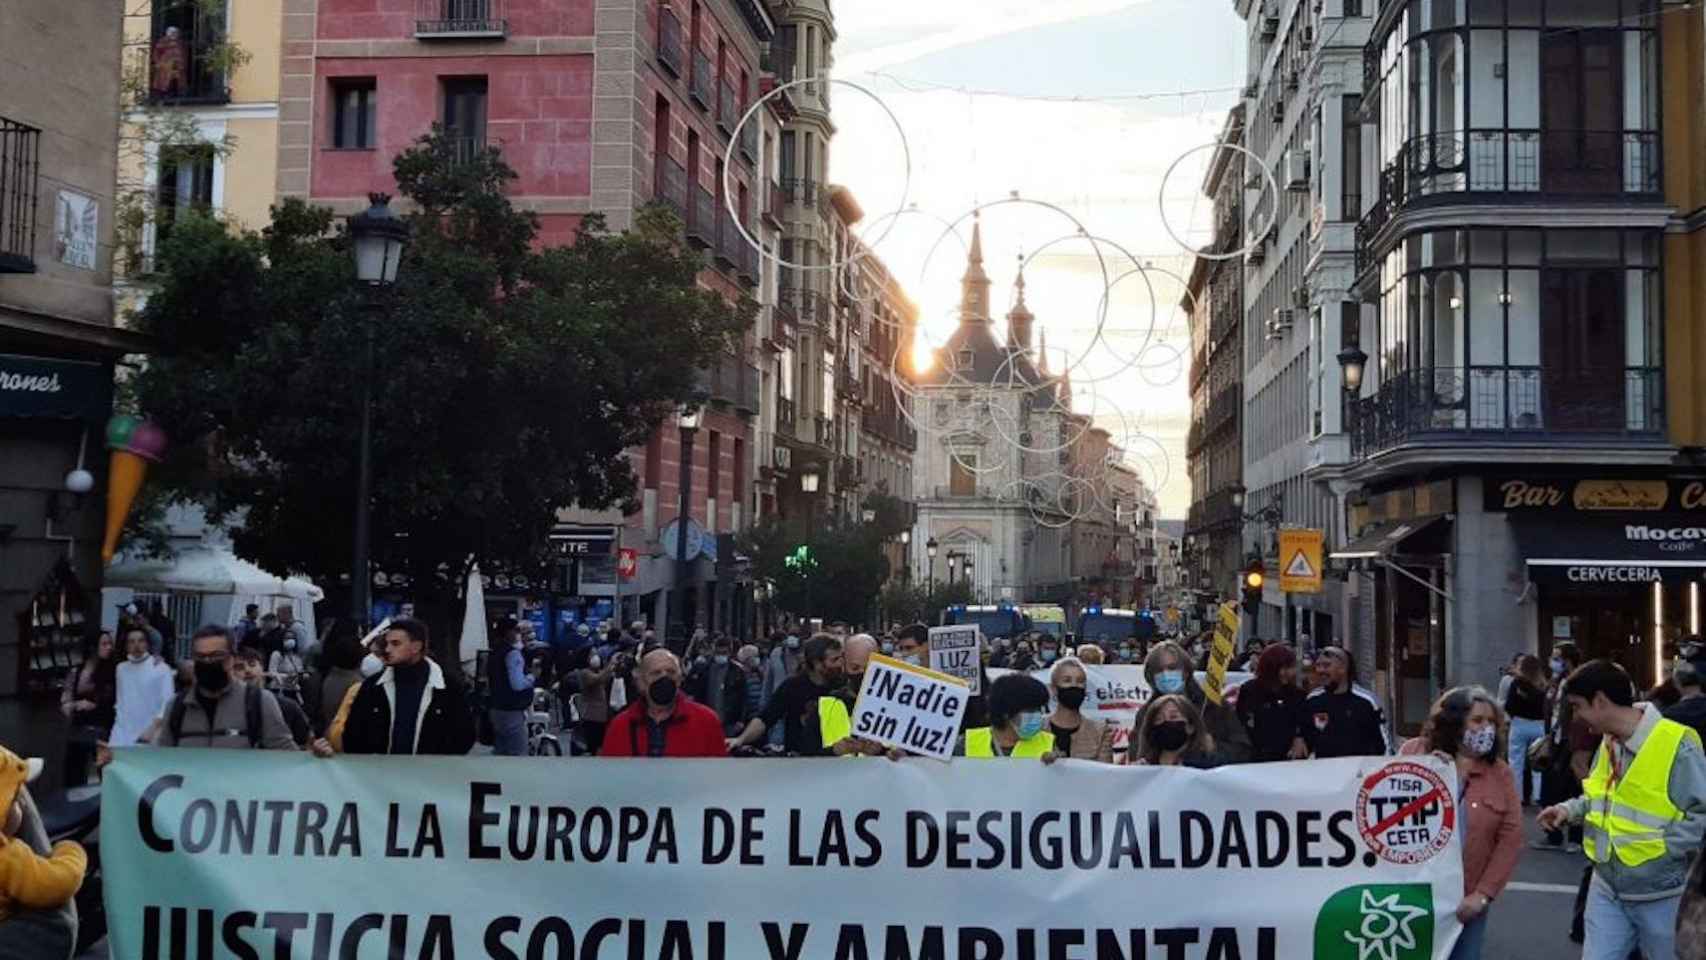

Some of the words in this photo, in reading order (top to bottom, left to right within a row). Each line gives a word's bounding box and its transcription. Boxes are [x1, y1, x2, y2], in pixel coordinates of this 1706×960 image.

[1500, 480, 1564, 508] Bar
[1681, 481, 1706, 510] C
[939, 650, 971, 669] LUZ
[866, 667, 960, 718] !Nadie
[857, 706, 899, 740] sin
[901, 715, 954, 755] luz!
[1389, 778, 1423, 793] TISA
[1369, 796, 1440, 827] TTIP
[384, 802, 446, 859] LA
[701, 807, 766, 865] DE
[788, 808, 883, 868] LAS
[1386, 828, 1431, 847] CETA
